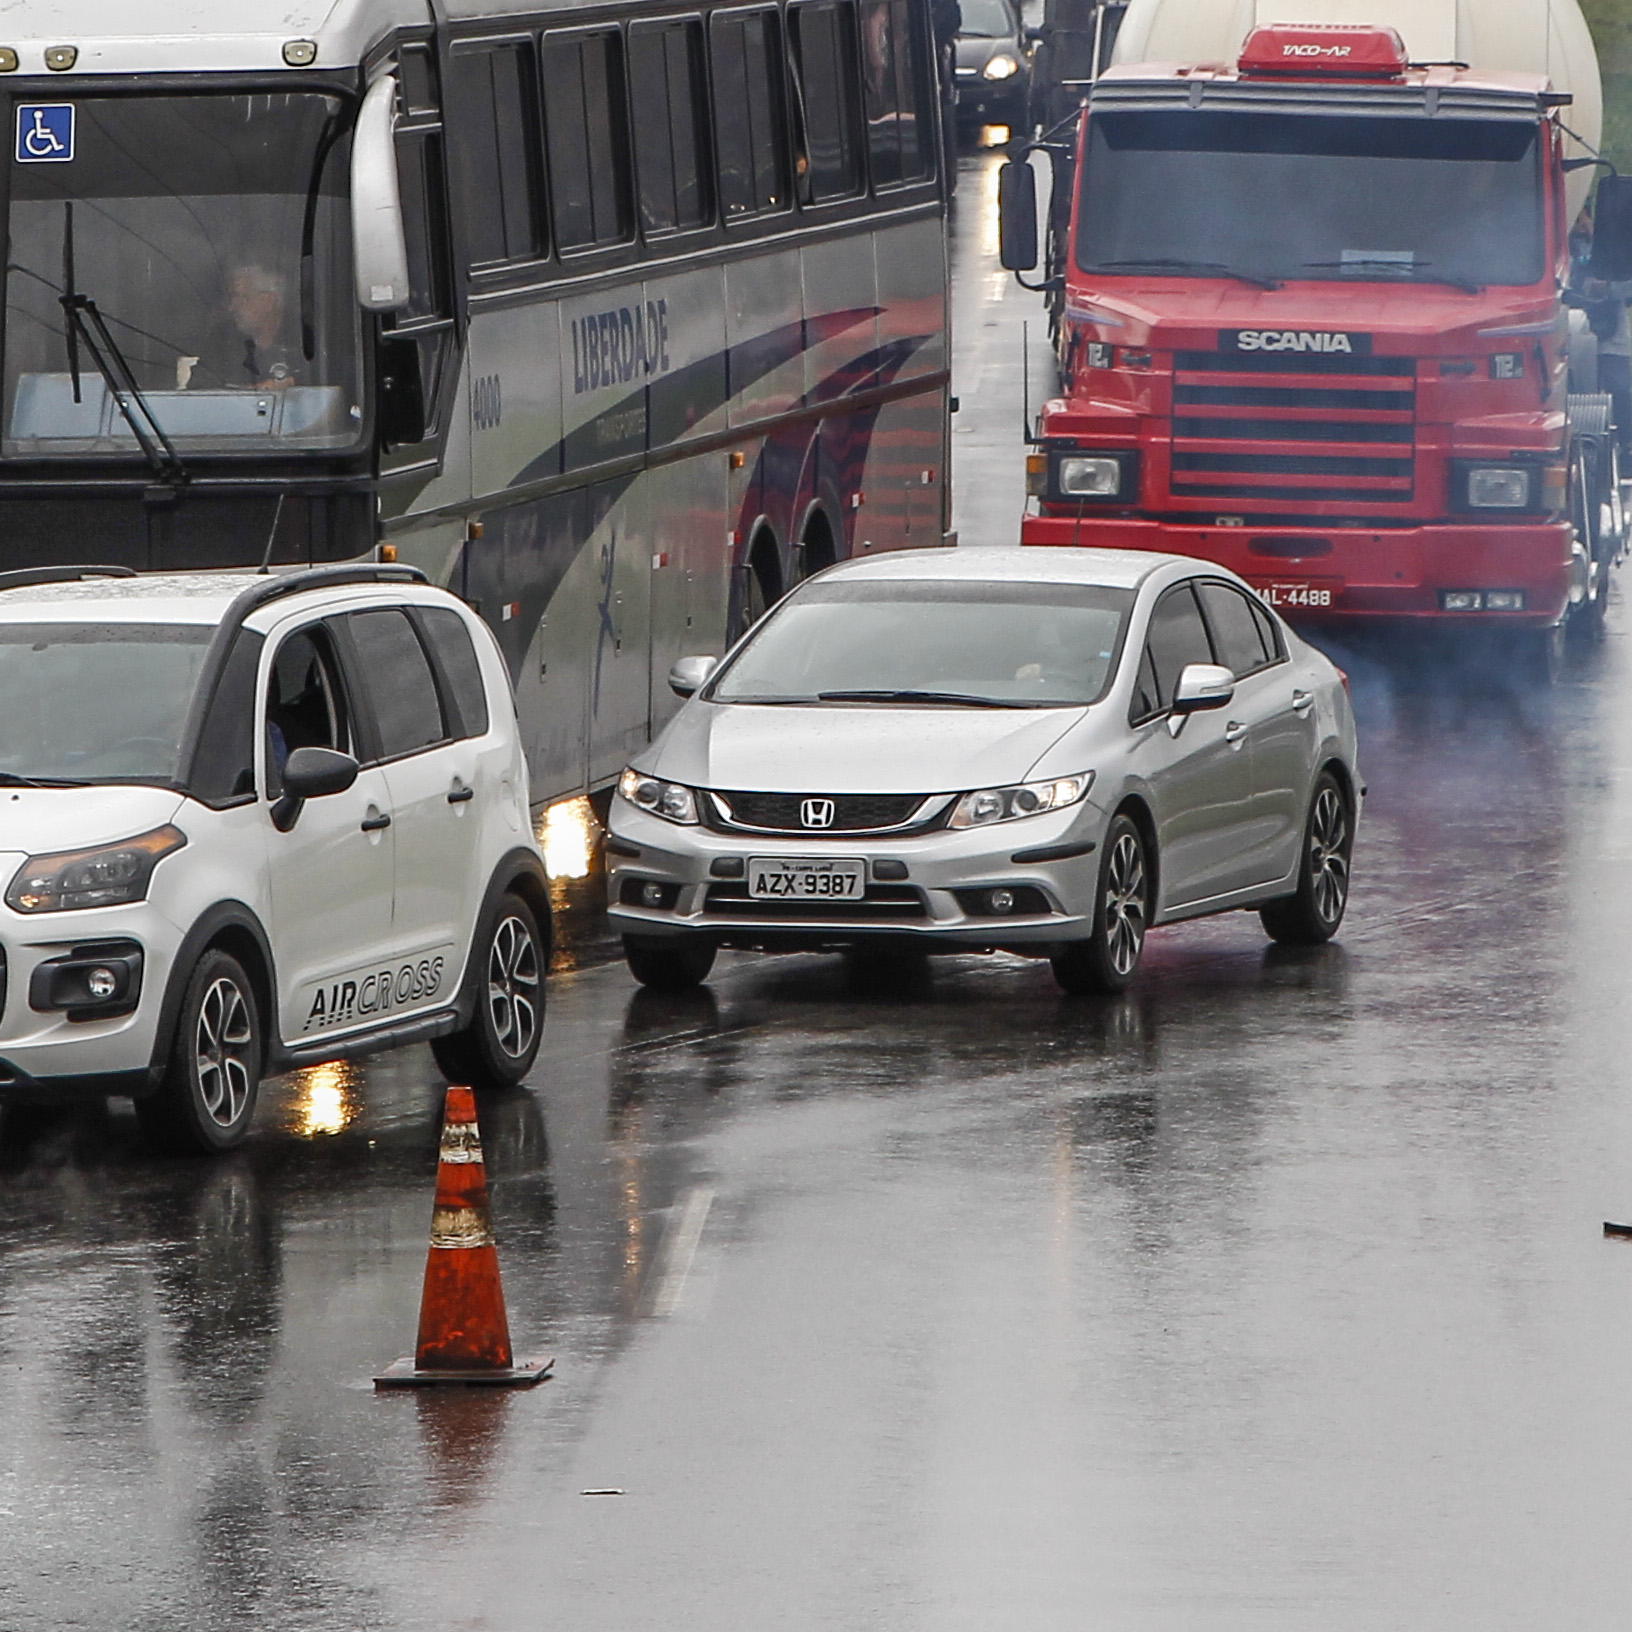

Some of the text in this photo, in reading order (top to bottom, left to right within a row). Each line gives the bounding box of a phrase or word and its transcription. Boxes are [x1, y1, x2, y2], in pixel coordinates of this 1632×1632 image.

[572, 298, 669, 395] LIBERDADE
[1236, 329, 1352, 354] SCANIA
[473, 372, 502, 431] 4000
[755, 873, 858, 894] AZX-9387
[302, 956, 444, 1032] AIRCROSS
